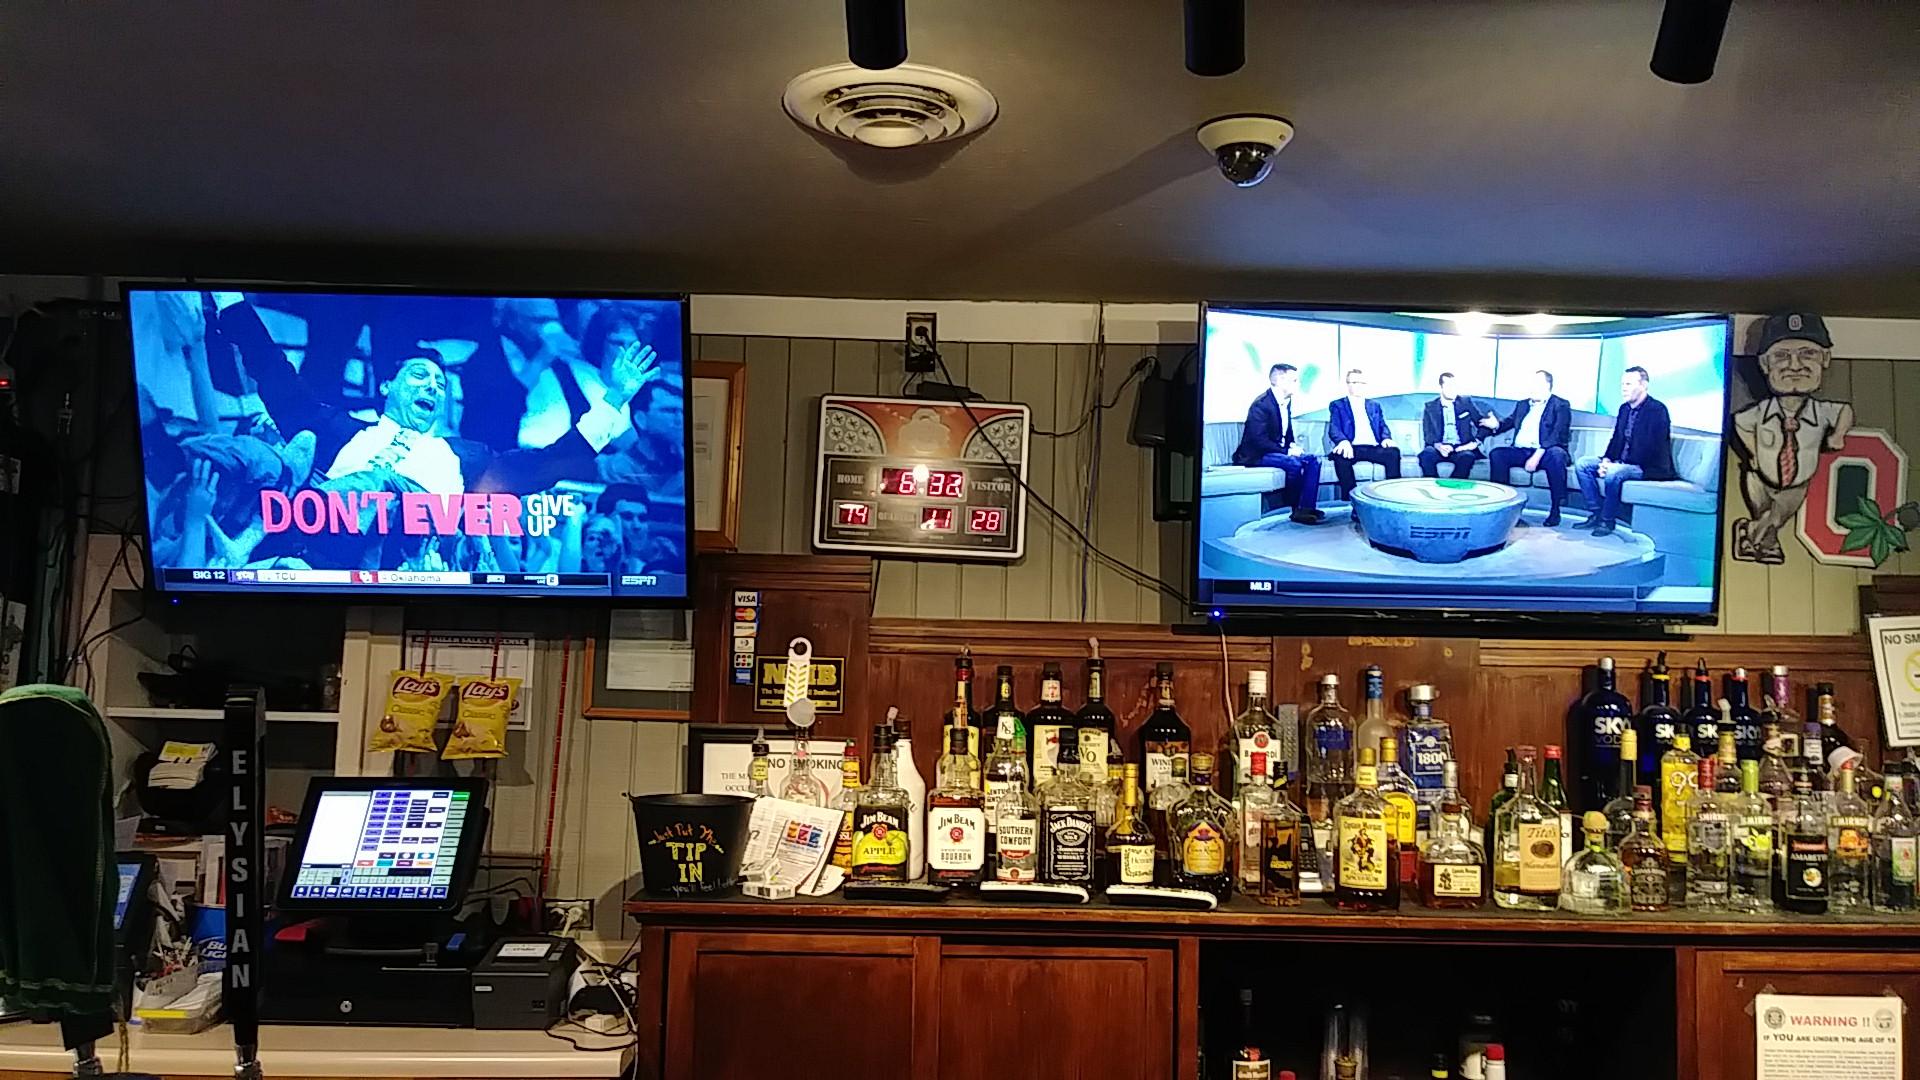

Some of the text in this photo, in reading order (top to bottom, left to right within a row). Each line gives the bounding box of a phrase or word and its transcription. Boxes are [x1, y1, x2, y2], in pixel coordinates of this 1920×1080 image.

[836, 474, 864, 484] HOME
[970, 480, 1012, 492] VISITOR
[527, 494, 575, 517] GIVE
[260, 489, 525, 537] DON'T EVER
[528, 515, 557, 537] UP
[971, 510, 1000, 531] 28
[1410, 525, 1472, 540] ESPN
[192, 570, 212, 580] BIG
[213, 570, 226, 580] 12
[275, 572, 297, 581] TCU
[621, 575, 657, 586] ESPN
[1249, 581, 1272, 591] MLB
[737, 595, 756, 603] VISA
[1884, 634, 1901, 645] NO
[768, 758, 786, 769] NO
[860, 811, 900, 829] JIM BEAM
[938, 813, 975, 830] JIM BEAM
[999, 826, 1033, 836] SOUTHERN
[1050, 819, 1067, 833] JACK
[1527, 827, 1557, 838] Tito's
[1000, 836, 1031, 845] COMFORT
[666, 841, 708, 862] TIP
[863, 847, 896, 856] APPLE
[940, 852, 972, 861] BOURBON
[230, 750, 251, 988] ELYSIAN
[678, 861, 704, 883] IN
[1790, 1015, 1858, 1027] WARNING
[1773, 1033, 1794, 1041] YOU
